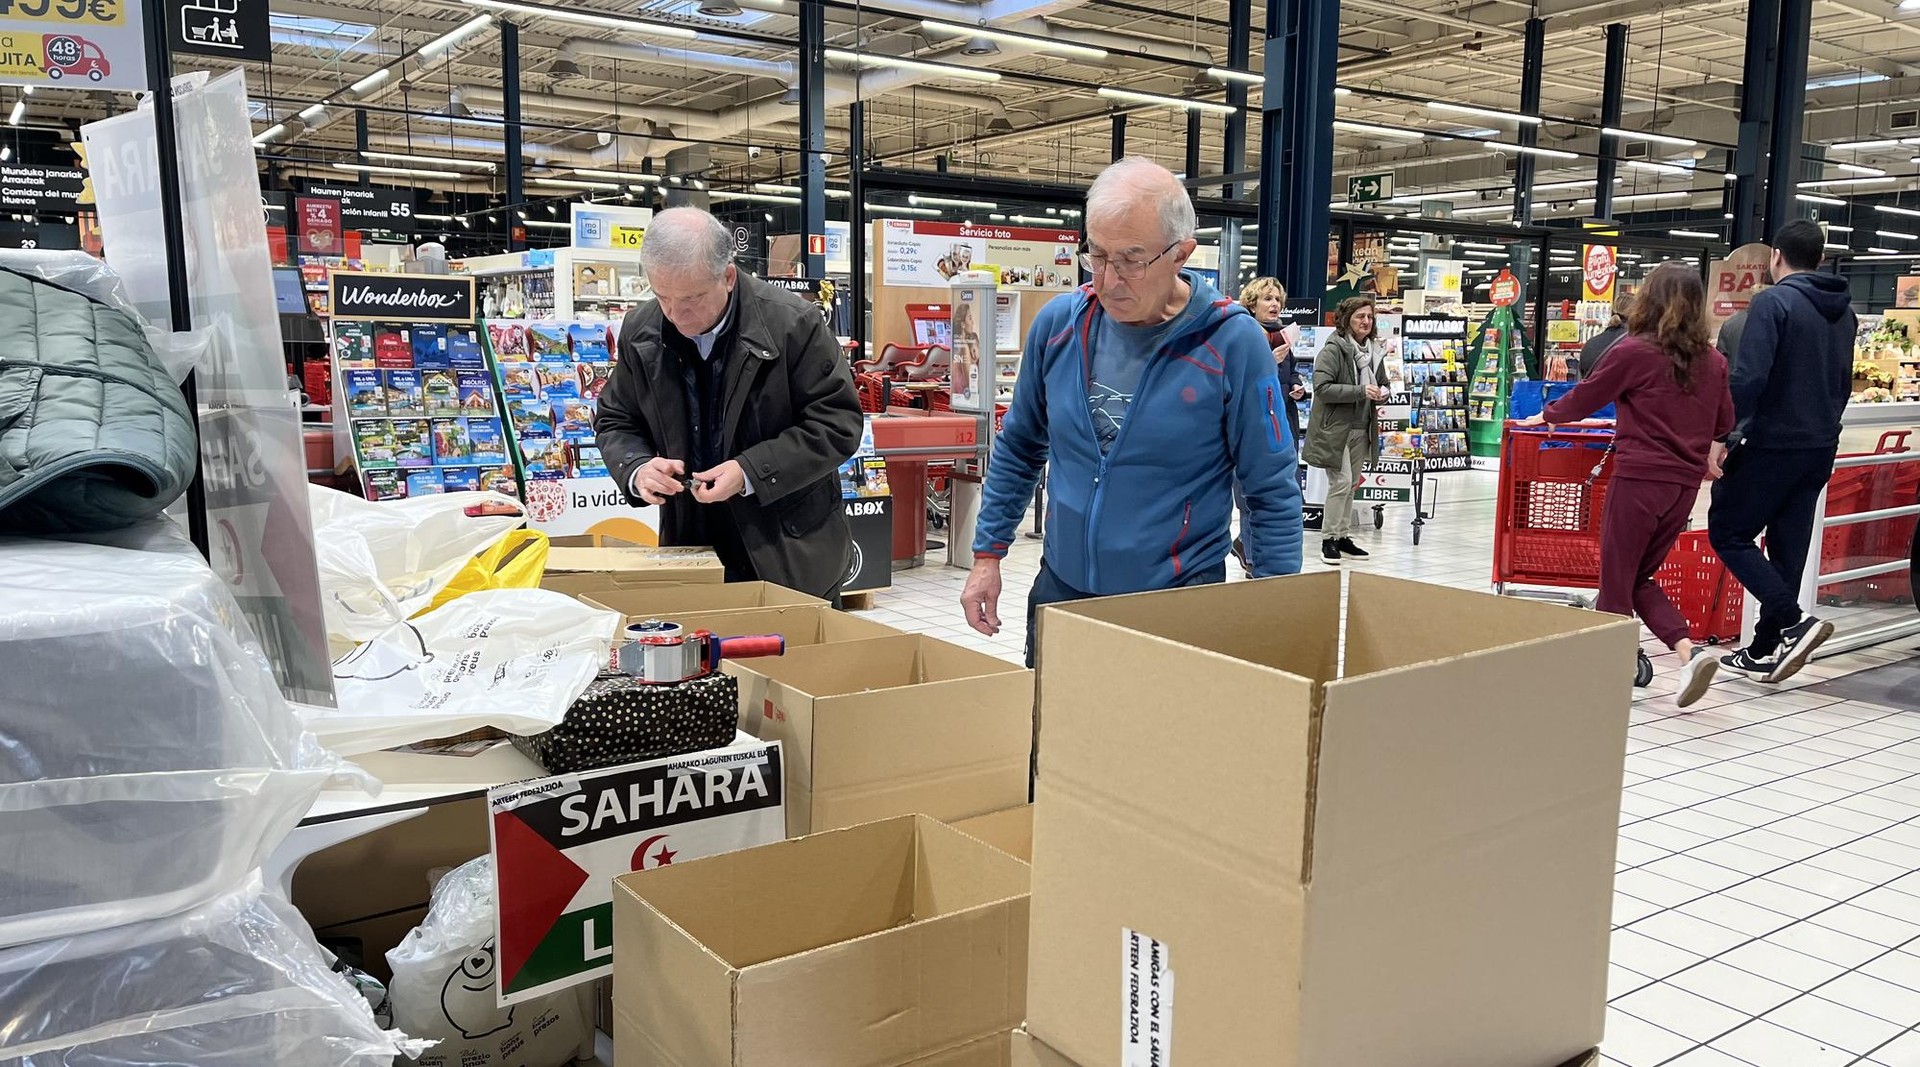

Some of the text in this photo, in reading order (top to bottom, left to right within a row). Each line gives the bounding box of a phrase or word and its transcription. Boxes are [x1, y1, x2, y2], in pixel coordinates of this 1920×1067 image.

[52, 41, 76, 56] 48
[53, 54, 76, 62] horas
[1, 166, 83, 179] Munduko janariak
[1, 175, 45, 185] Arrautzak
[1, 187, 44, 197] Comidas
[44, 189, 60, 198] del
[310, 186, 375, 199] Haurren janariak
[2, 196, 36, 205] Huevos
[317, 209, 327, 219] 4
[390, 202, 410, 217] 55
[959, 226, 1012, 239] Servicio foto
[21, 239, 36, 249] 29
[1560, 275, 1569, 283] 10
[341, 285, 456, 309] Wonderbox
[572, 492, 587, 508] la
[1363, 488, 1399, 500] LIBRE
[701, 755, 733, 767] LAGUNEN
[733, 751, 756, 762] EUSKAL
[519, 780, 564, 798] FEDERAZIOA
[559, 764, 770, 837] SAHARA
[1150, 938, 1160, 988] AMIGAS
[1130, 971, 1140, 1044] FEDERAZIOA
[1150, 990, 1160, 1020] CON
[1150, 1021, 1160, 1033] EL
